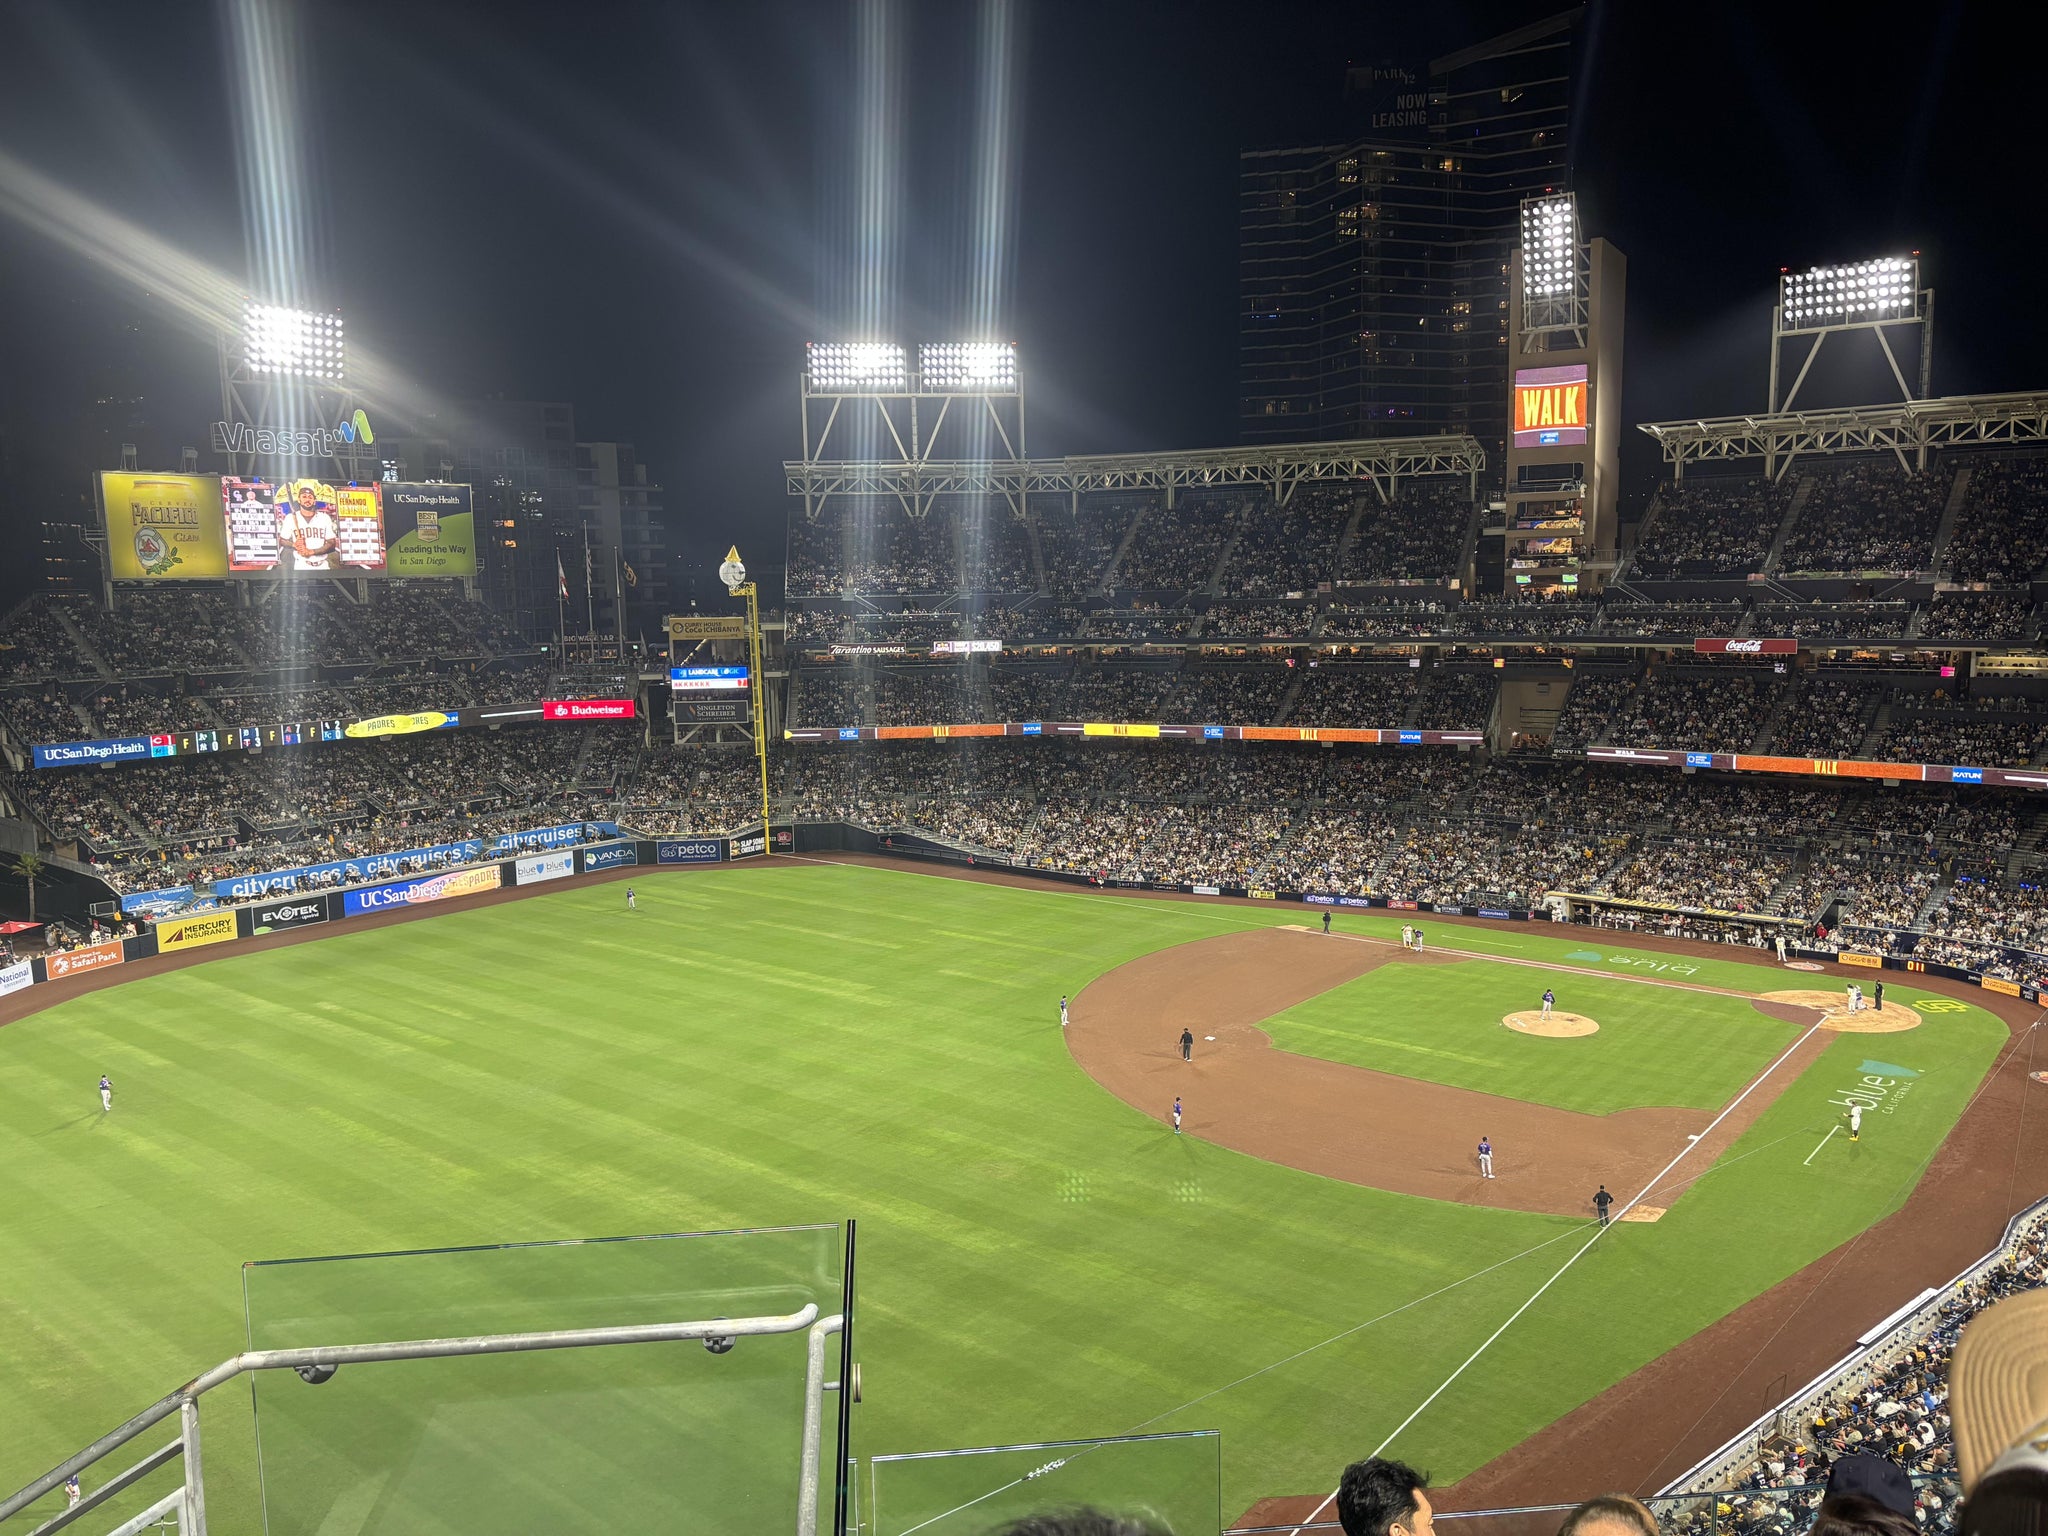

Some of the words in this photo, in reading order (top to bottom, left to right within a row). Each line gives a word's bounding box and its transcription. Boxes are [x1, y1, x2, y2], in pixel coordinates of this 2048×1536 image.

[1397, 93, 1427, 110] NOW
[1372, 110, 1427, 128] LEASING
[1522, 386, 1579, 427] WALK
[218, 421, 333, 457] Viasat
[393, 494, 405, 503] UC
[406, 494, 418, 503] San
[419, 494, 438, 505] Diego
[439, 495, 460, 504] Health
[398, 545, 432, 554] Leading
[433, 545, 447, 553] the
[449, 545, 466, 554] Way
[400, 557, 407, 565] in
[410, 557, 424, 565] San
[426, 557, 446, 566] Diego
[830, 645, 872, 654] Tarantino
[571, 705, 624, 715] Budweiser
[294, 724, 301, 733] 7
[334, 720, 340, 729] 2
[367, 719, 395, 731] PADRES
[212, 731, 216, 741] 1
[255, 727, 260, 737] 1
[269, 730, 275, 741] F
[310, 727, 316, 737] F
[1113, 726, 1128, 735] WALK
[1300, 729, 1318, 740] WALK
[167, 735, 172, 745] 1
[183, 738, 189, 749] F
[227, 734, 233, 745] F
[255, 737, 261, 747] 3
[44, 749, 62, 760] UC
[62, 748, 83, 758] San
[83, 746, 112, 757] Diego
[112, 743, 145, 754] Health
[1814, 760, 1838, 775] WALK
[1952, 771, 1982, 779] KATUN
[597, 849, 635, 861] VANDA
[678, 844, 716, 858] petco
[518, 866, 536, 875] blue
[546, 861, 564, 870] blue
[360, 892, 382, 908] UC
[383, 888, 409, 904] San
[1315, 895, 1334, 903] petco
[1348, 898, 1368, 906] petco
[262, 904, 318, 922] EVOTEK
[184, 918, 231, 934] MERCURY
[185, 926, 232, 940] INSURANCE
[71, 956, 97, 969] Safari
[98, 952, 117, 962] Park
[0, 967, 29, 984] National
[1828, 1075, 1896, 1111] blue
